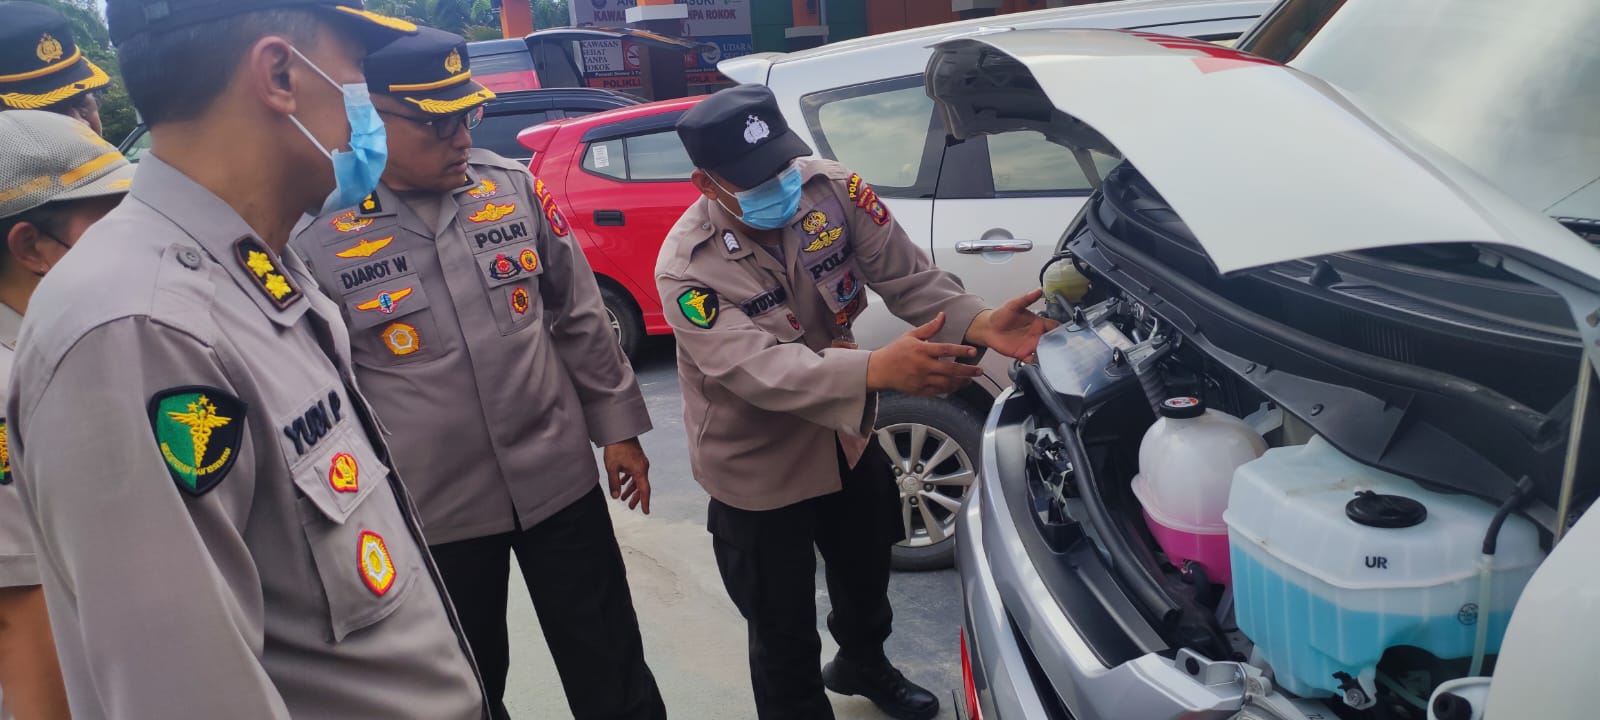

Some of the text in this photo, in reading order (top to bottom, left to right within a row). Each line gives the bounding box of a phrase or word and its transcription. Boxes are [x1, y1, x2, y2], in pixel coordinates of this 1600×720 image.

[705, 9, 737, 20] ROKOK
[474, 221, 528, 249] POLRI
[340, 255, 408, 289] DJAROT W
[327, 389, 341, 422] P
[1365, 555, 1388, 570] UR
